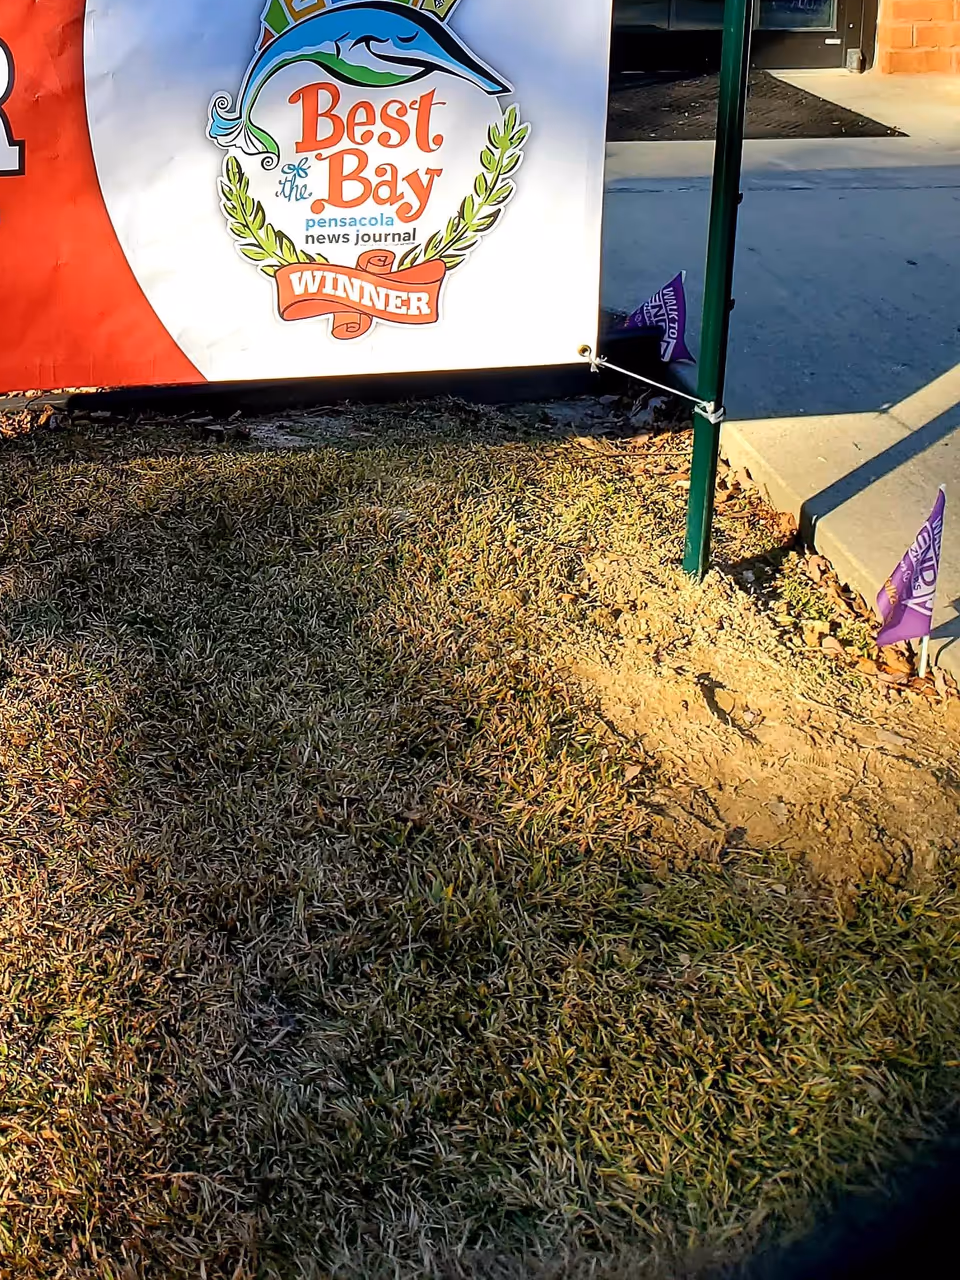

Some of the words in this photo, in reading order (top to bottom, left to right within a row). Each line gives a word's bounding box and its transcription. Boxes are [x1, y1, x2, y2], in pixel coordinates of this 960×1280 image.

[287, 81, 447, 154] Best
[281, 157, 311, 179] of
[275, 177, 313, 202] the
[311, 147, 444, 223] Bay
[305, 213, 394, 230] pensacola
[305, 231, 350, 245] news
[354, 228, 417, 246] journal
[288, 269, 431, 316] WINNER
[664, 287, 678, 320] WALK
[669, 323, 678, 338] TO
